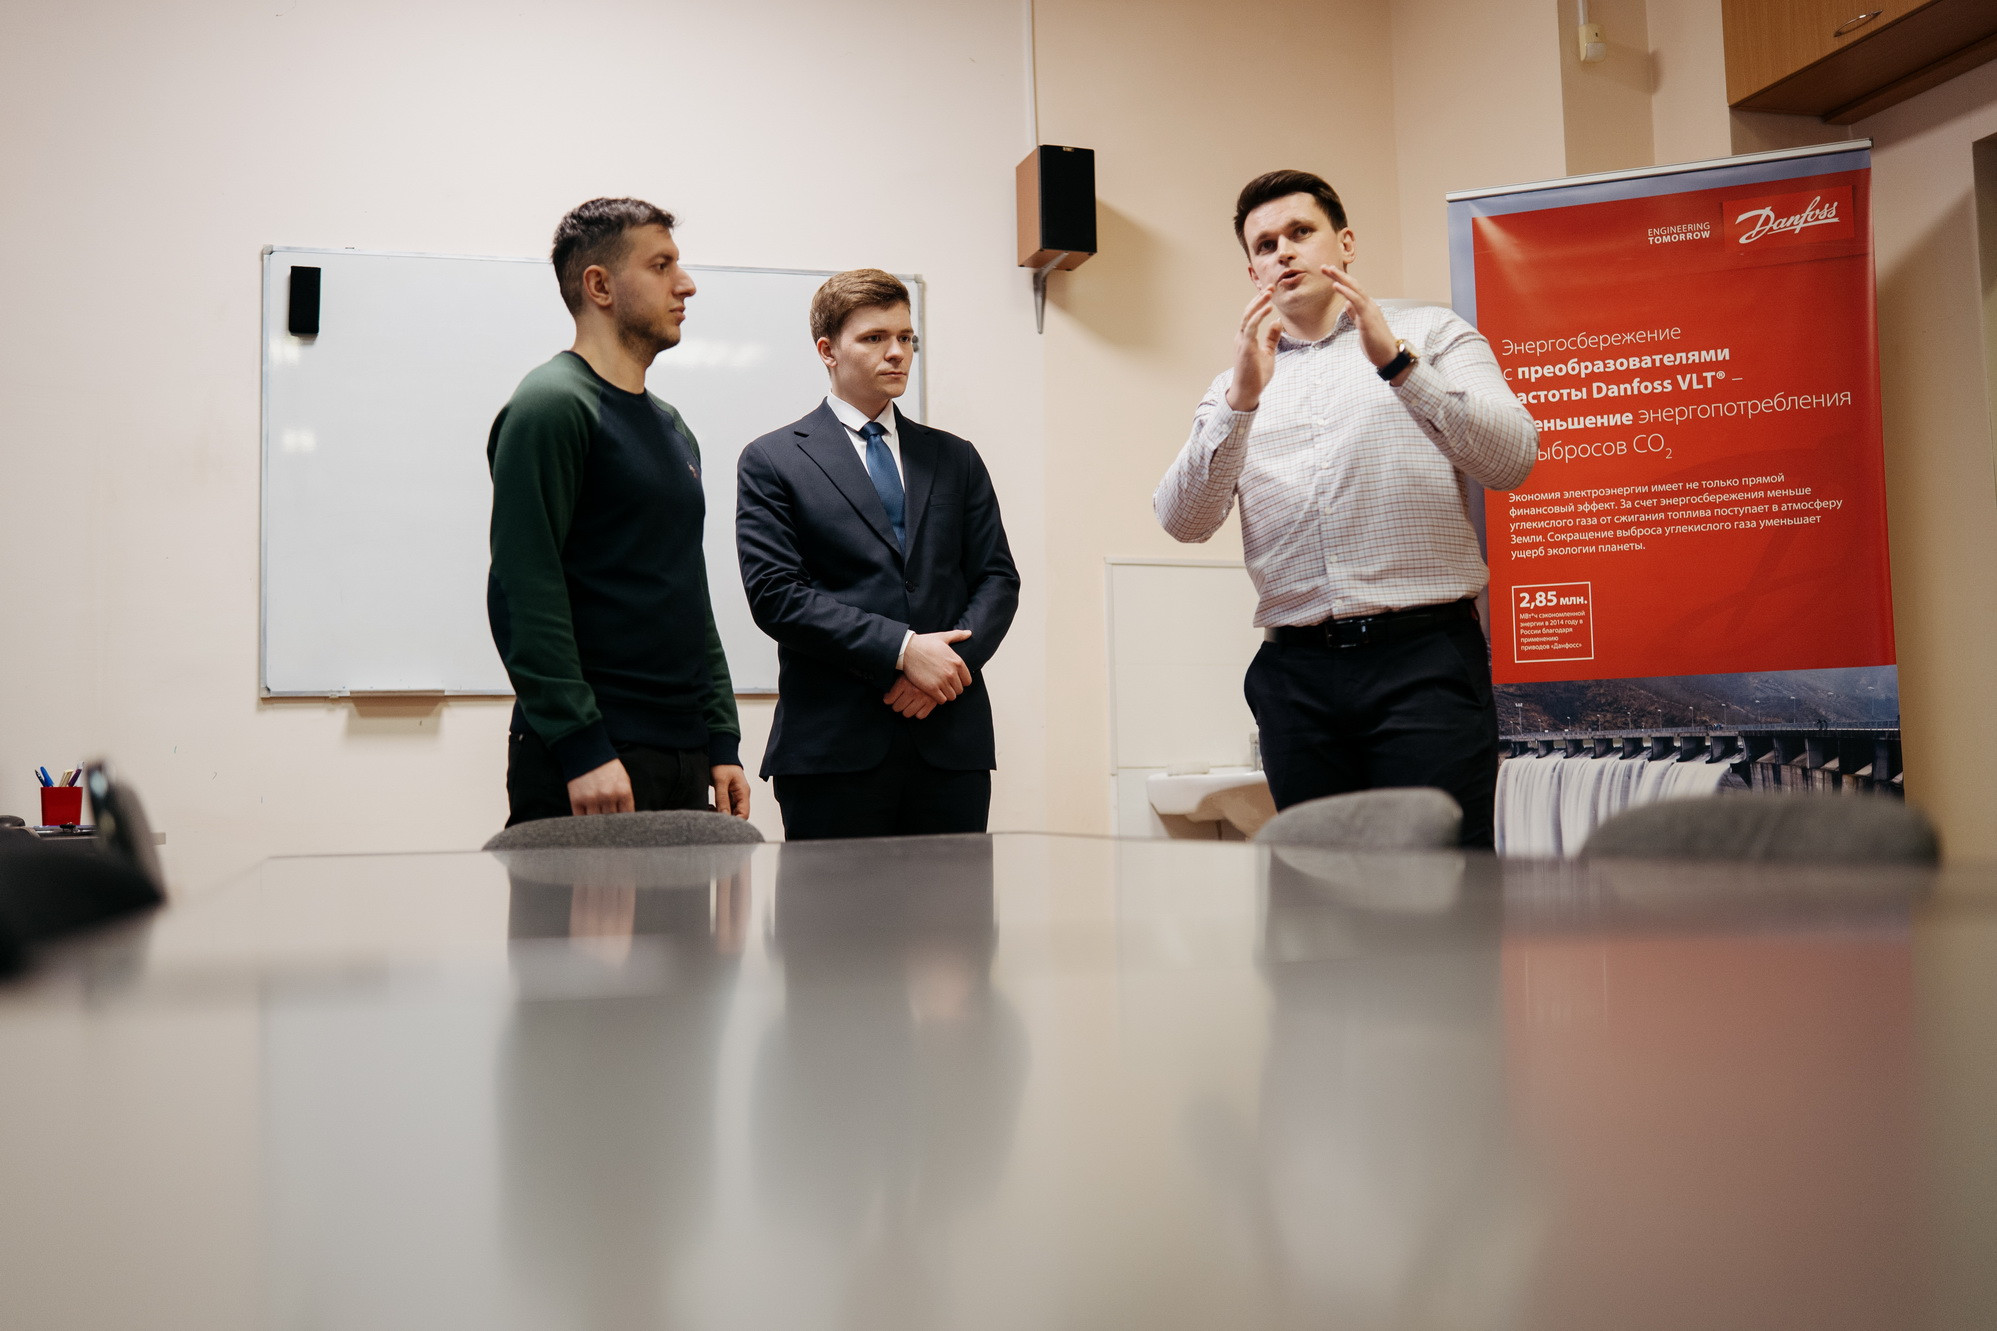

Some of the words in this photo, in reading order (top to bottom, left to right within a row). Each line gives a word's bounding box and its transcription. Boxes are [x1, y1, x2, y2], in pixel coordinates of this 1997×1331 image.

[1648, 222, 1711, 236] ENGINEERING
[1735, 196, 1840, 244] Danfoss
[1648, 230, 1711, 245] TOMORROW
[1501, 326, 1681, 356] Энергосбережение
[1503, 368, 1513, 381] с
[1517, 348, 1730, 382] преобразователями
[1516, 387, 1587, 404] астоты
[1592, 378, 1673, 398] Danfoss
[1676, 371, 1726, 391] VLT®
[1534, 412, 1633, 432] еньшение
[1638, 391, 1851, 425] энергопотребления
[1538, 441, 1627, 463] ыбросов
[1508, 491, 1561, 503] Экономия
[1563, 484, 1649, 500] электроэнергии
[1651, 482, 1683, 493] имеет
[1686, 481, 1699, 490] не
[1701, 478, 1739, 489] только
[1742, 473, 1785, 487] прямой
[1509, 502, 1575, 518] финансовый
[1577, 502, 1618, 513] эффект.
[1620, 499, 1632, 509] За
[1634, 498, 1657, 508] счет
[1660, 489, 1764, 506] энергосбережения
[1767, 486, 1812, 498] меньше
[1509, 518, 1574, 532] углекислого
[1576, 517, 1597, 526] газа
[1600, 516, 1612, 525] от
[1614, 511, 1665, 523] сжигания
[1667, 508, 1711, 519] топлива
[1714, 504, 1769, 517] поступает
[1772, 503, 1778, 512] в
[1781, 498, 1843, 511] атмосферу
[1510, 534, 1545, 544] Земли.
[1547, 530, 1614, 543] Сокращение
[1616, 525, 1662, 538] выброса
[1664, 521, 1731, 536] углекислого
[1734, 520, 1756, 529] газа
[1759, 515, 1821, 529] уменьшает
[1511, 546, 1545, 560] ущерб
[1547, 544, 1596, 557] экологии
[1598, 541, 1646, 553] планеты.
[1519, 591, 1557, 609] 2,85
[1560, 596, 1588, 606] млн.
[1539, 610, 1586, 619] сэкономленной
[1520, 636, 1559, 644] применению
[1542, 627, 1573, 635] благодаря
